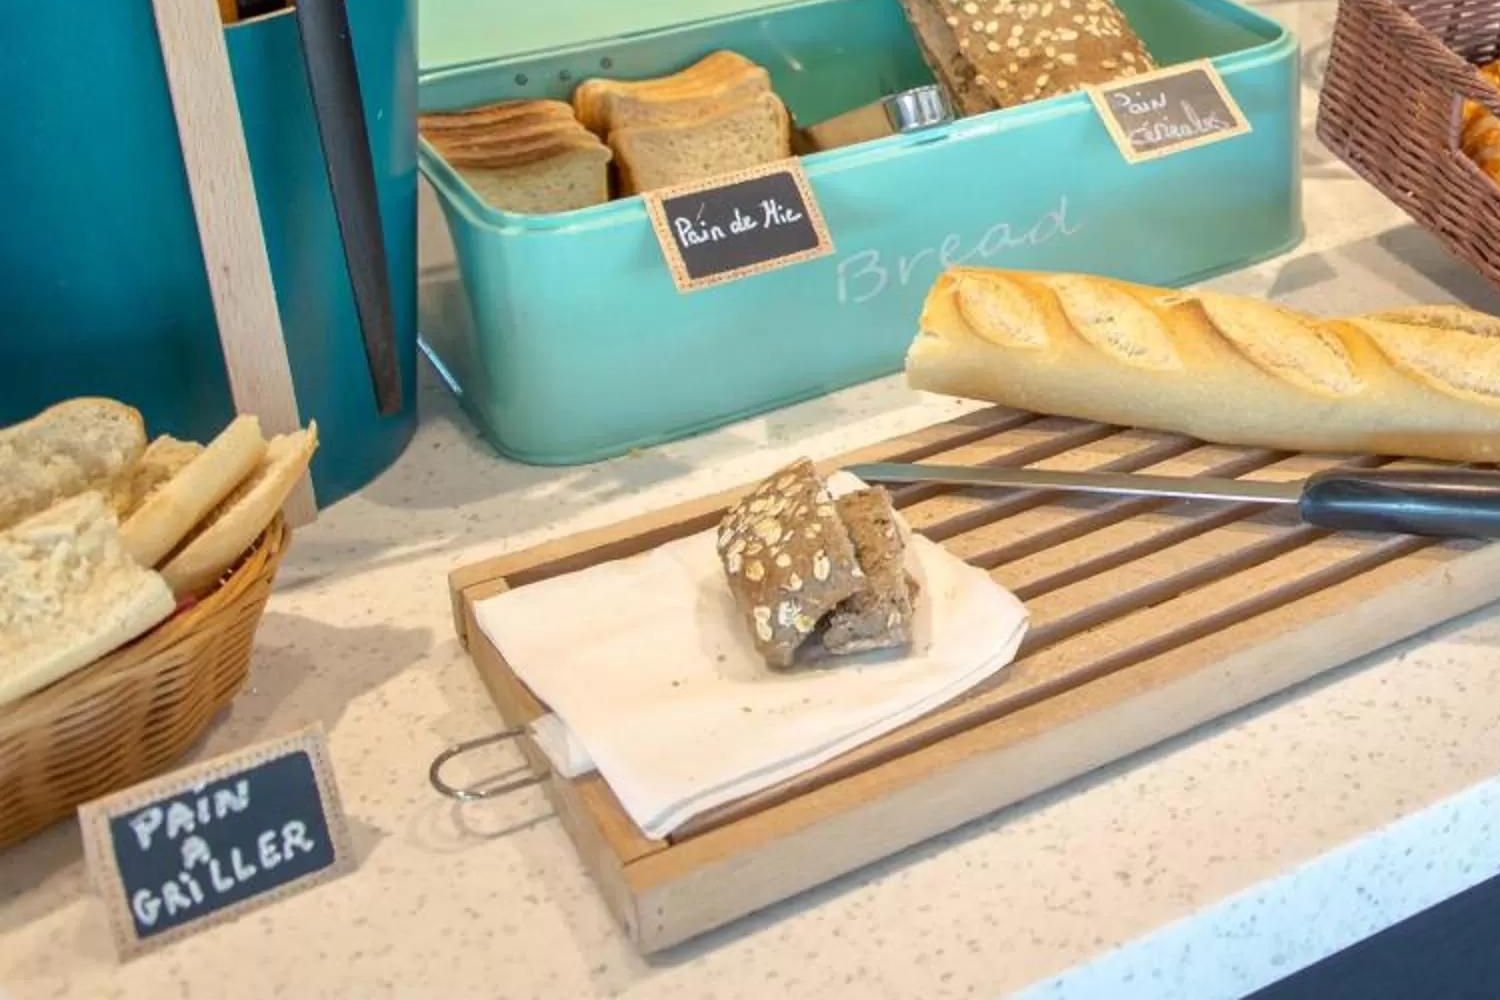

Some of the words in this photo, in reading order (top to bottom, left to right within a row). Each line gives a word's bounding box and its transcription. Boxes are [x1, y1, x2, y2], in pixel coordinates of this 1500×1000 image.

[674, 212, 727, 248] Pain
[730, 207, 758, 235] de
[761, 199, 803, 229] Mie
[837, 195, 1082, 304] Bread
